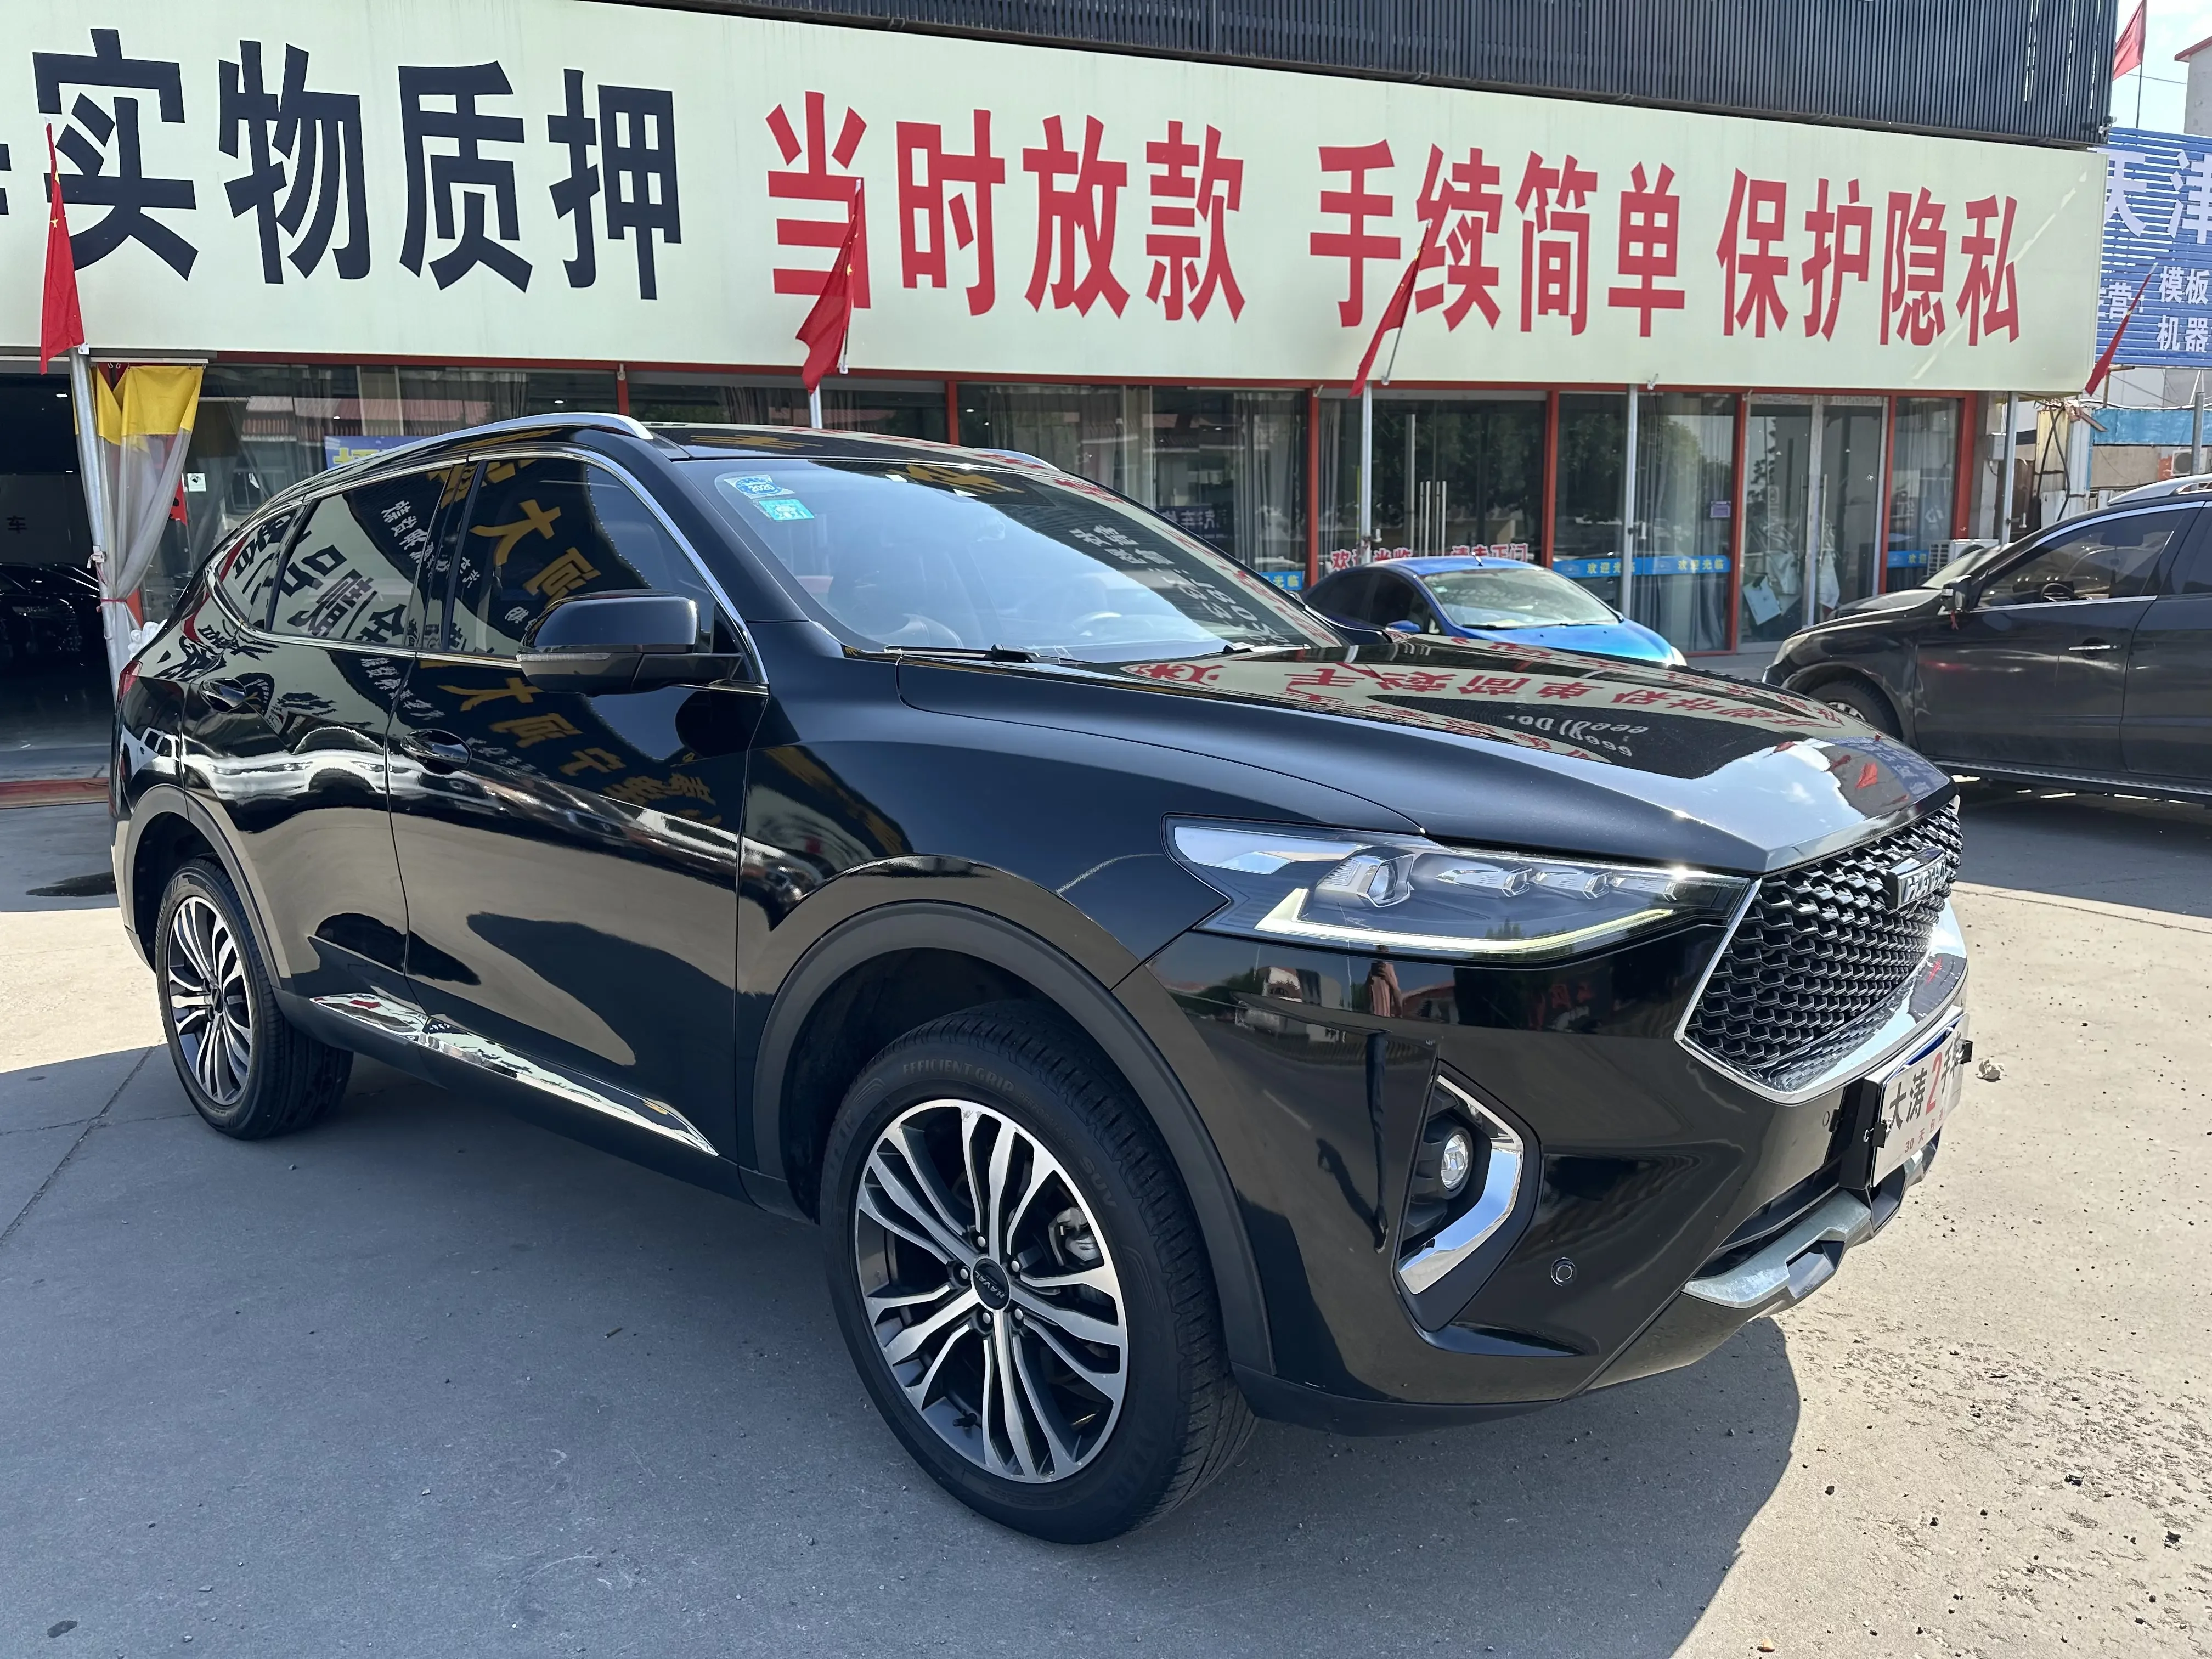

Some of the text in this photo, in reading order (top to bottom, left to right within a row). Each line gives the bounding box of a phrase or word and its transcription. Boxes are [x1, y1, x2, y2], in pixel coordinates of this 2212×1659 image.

[0, 29, 2019, 346] 实物质押 当时放款 手续简单 保护隐私
[2159, 266, 2210, 305] 模板
[1677, 558, 1724, 572] 欢迎光临
